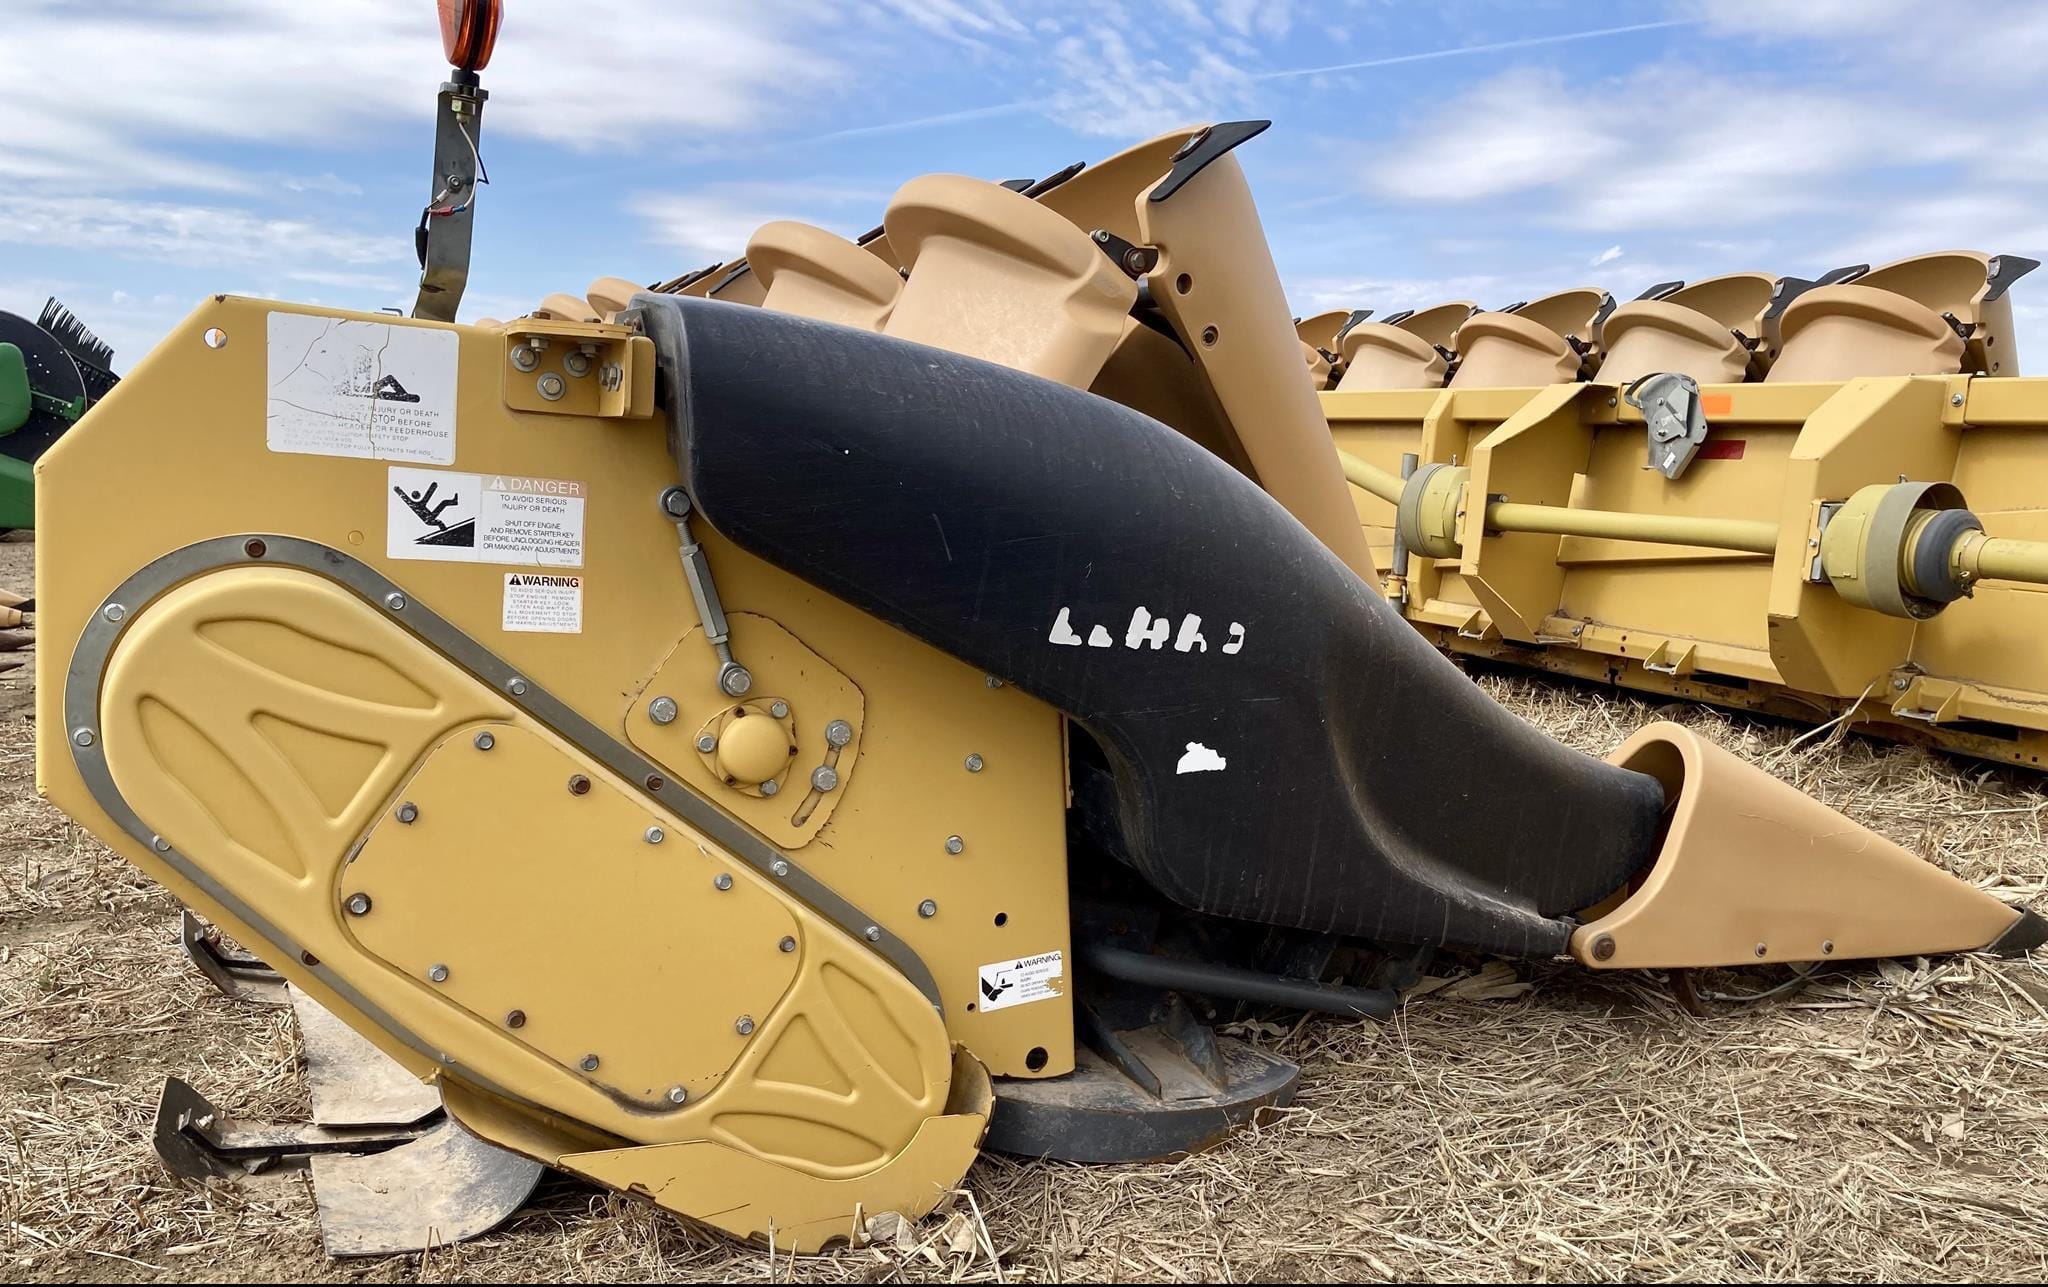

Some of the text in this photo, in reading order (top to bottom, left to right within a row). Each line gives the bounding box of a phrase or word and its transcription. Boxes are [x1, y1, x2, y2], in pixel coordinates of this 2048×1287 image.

[414, 409, 439, 417] DEATH
[372, 414, 395, 424] STOP
[398, 419, 432, 428] BEFORE
[338, 422, 371, 430] HEADER
[390, 426, 448, 438] FEEDERHOUSE
[511, 478, 579, 495] DANGER
[512, 495, 533, 503] AVOID
[536, 497, 567, 505] SERIOUS
[505, 528, 531, 536] REMOVE
[537, 522, 560, 530] ENGINE
[511, 536, 553, 545] UNCLOGGING
[494, 543, 519, 551] MAKING
[535, 546, 580, 555] ADJUSTMENTS
[523, 576, 579, 588] WARNING
[1024, 953, 1061, 967] WARNING
